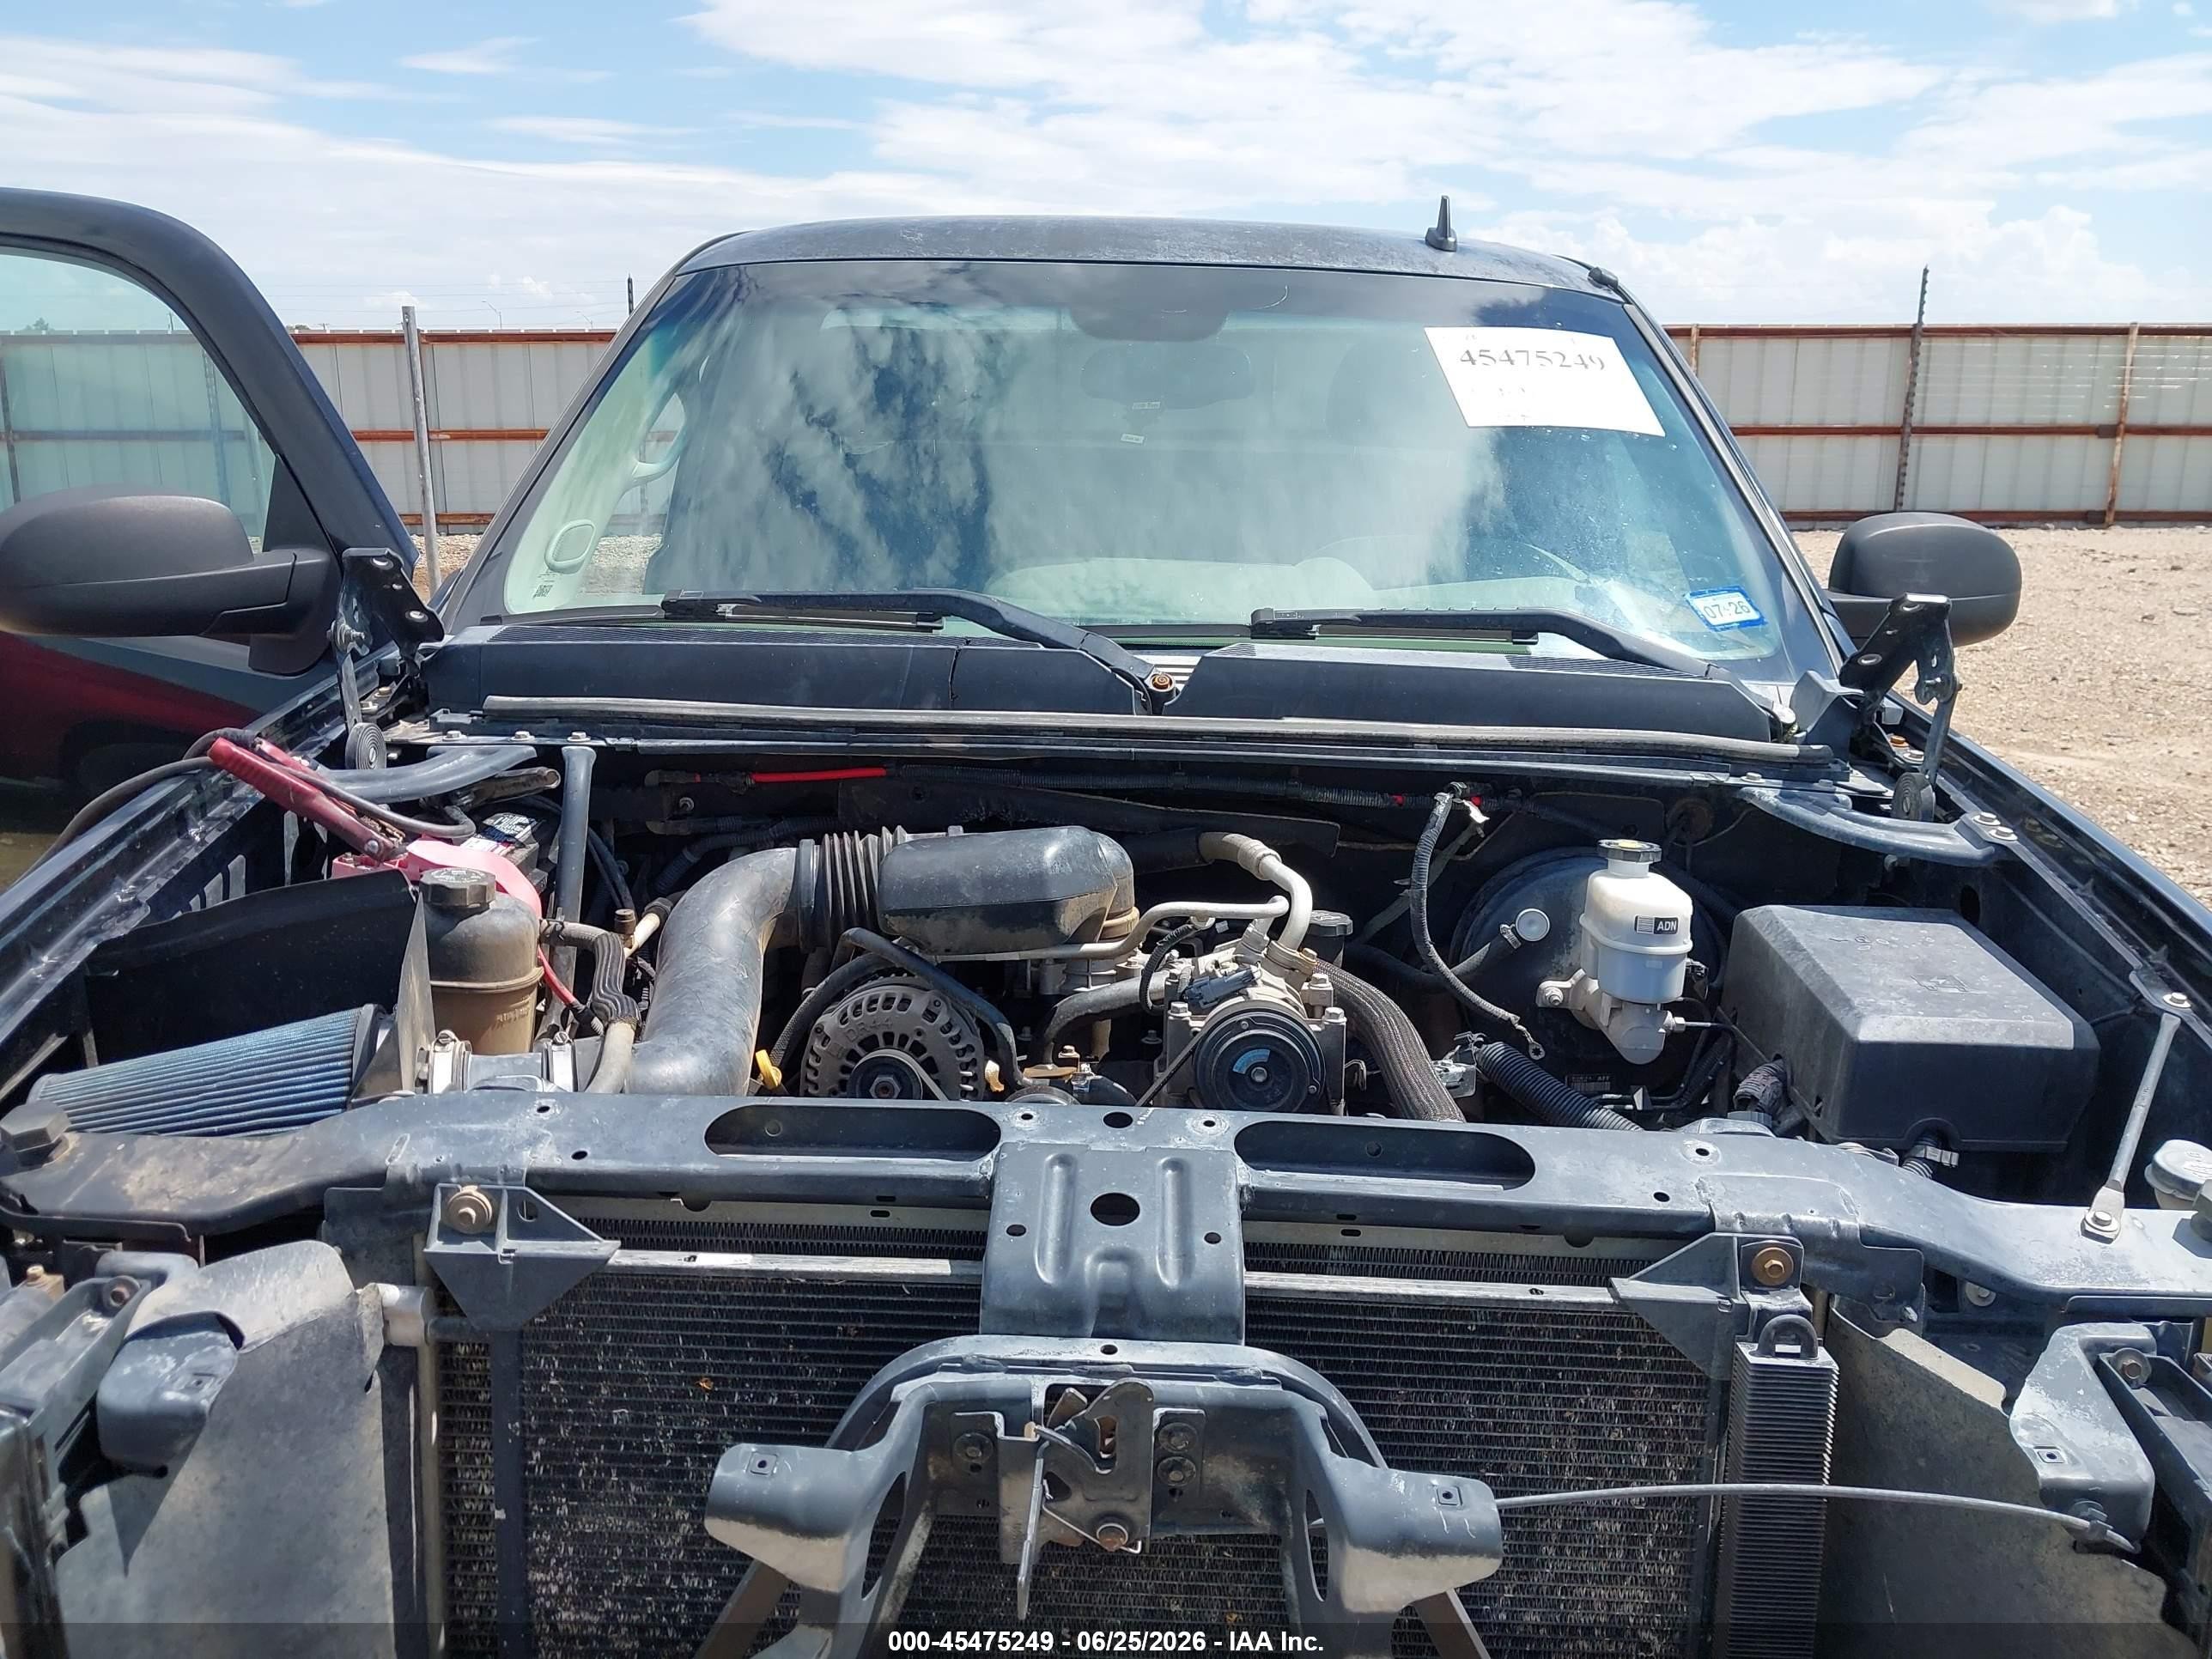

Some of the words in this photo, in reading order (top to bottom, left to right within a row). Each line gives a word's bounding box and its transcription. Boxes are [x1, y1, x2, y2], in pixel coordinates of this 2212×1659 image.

[1703, 604, 1724, 619] 07
[1729, 600, 1751, 615] 26
[1656, 920, 1678, 932] ADN
